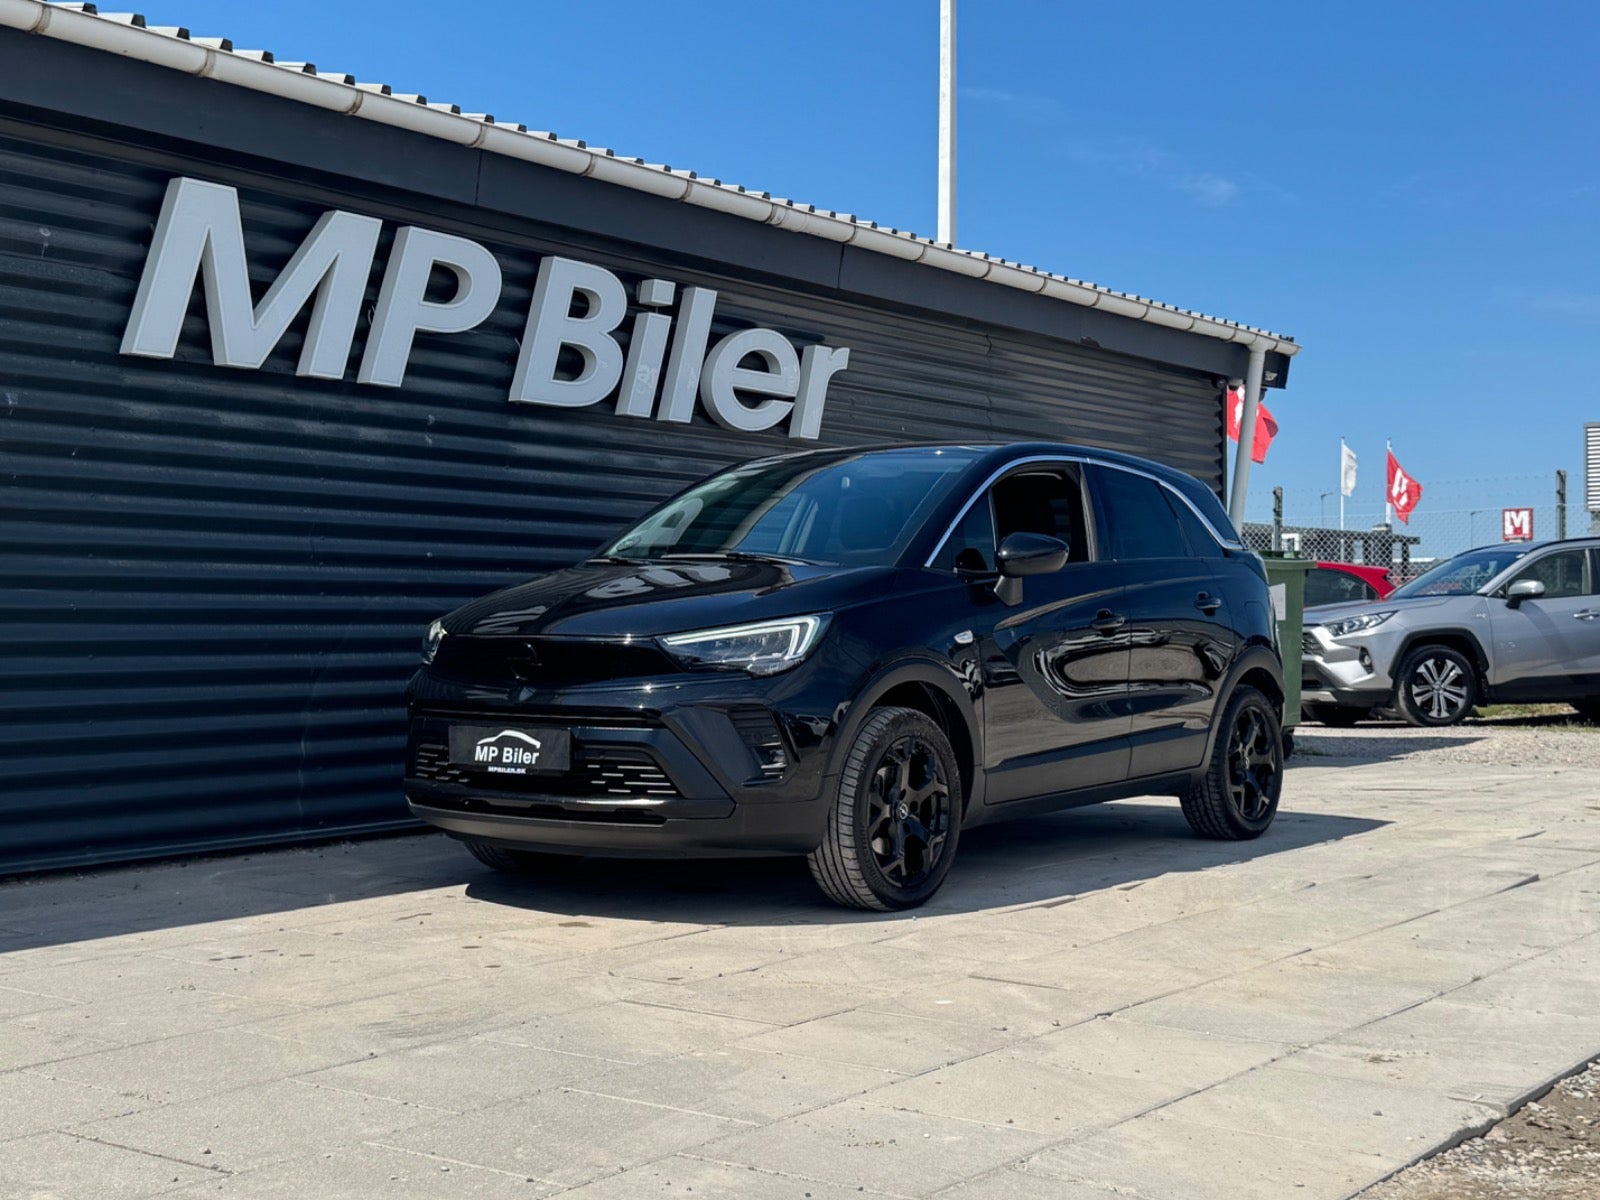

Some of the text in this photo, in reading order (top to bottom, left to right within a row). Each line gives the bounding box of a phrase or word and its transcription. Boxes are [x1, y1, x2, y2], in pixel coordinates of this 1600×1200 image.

[119, 176, 849, 439] MP Biler
[474, 745, 540, 764] MP Biler
